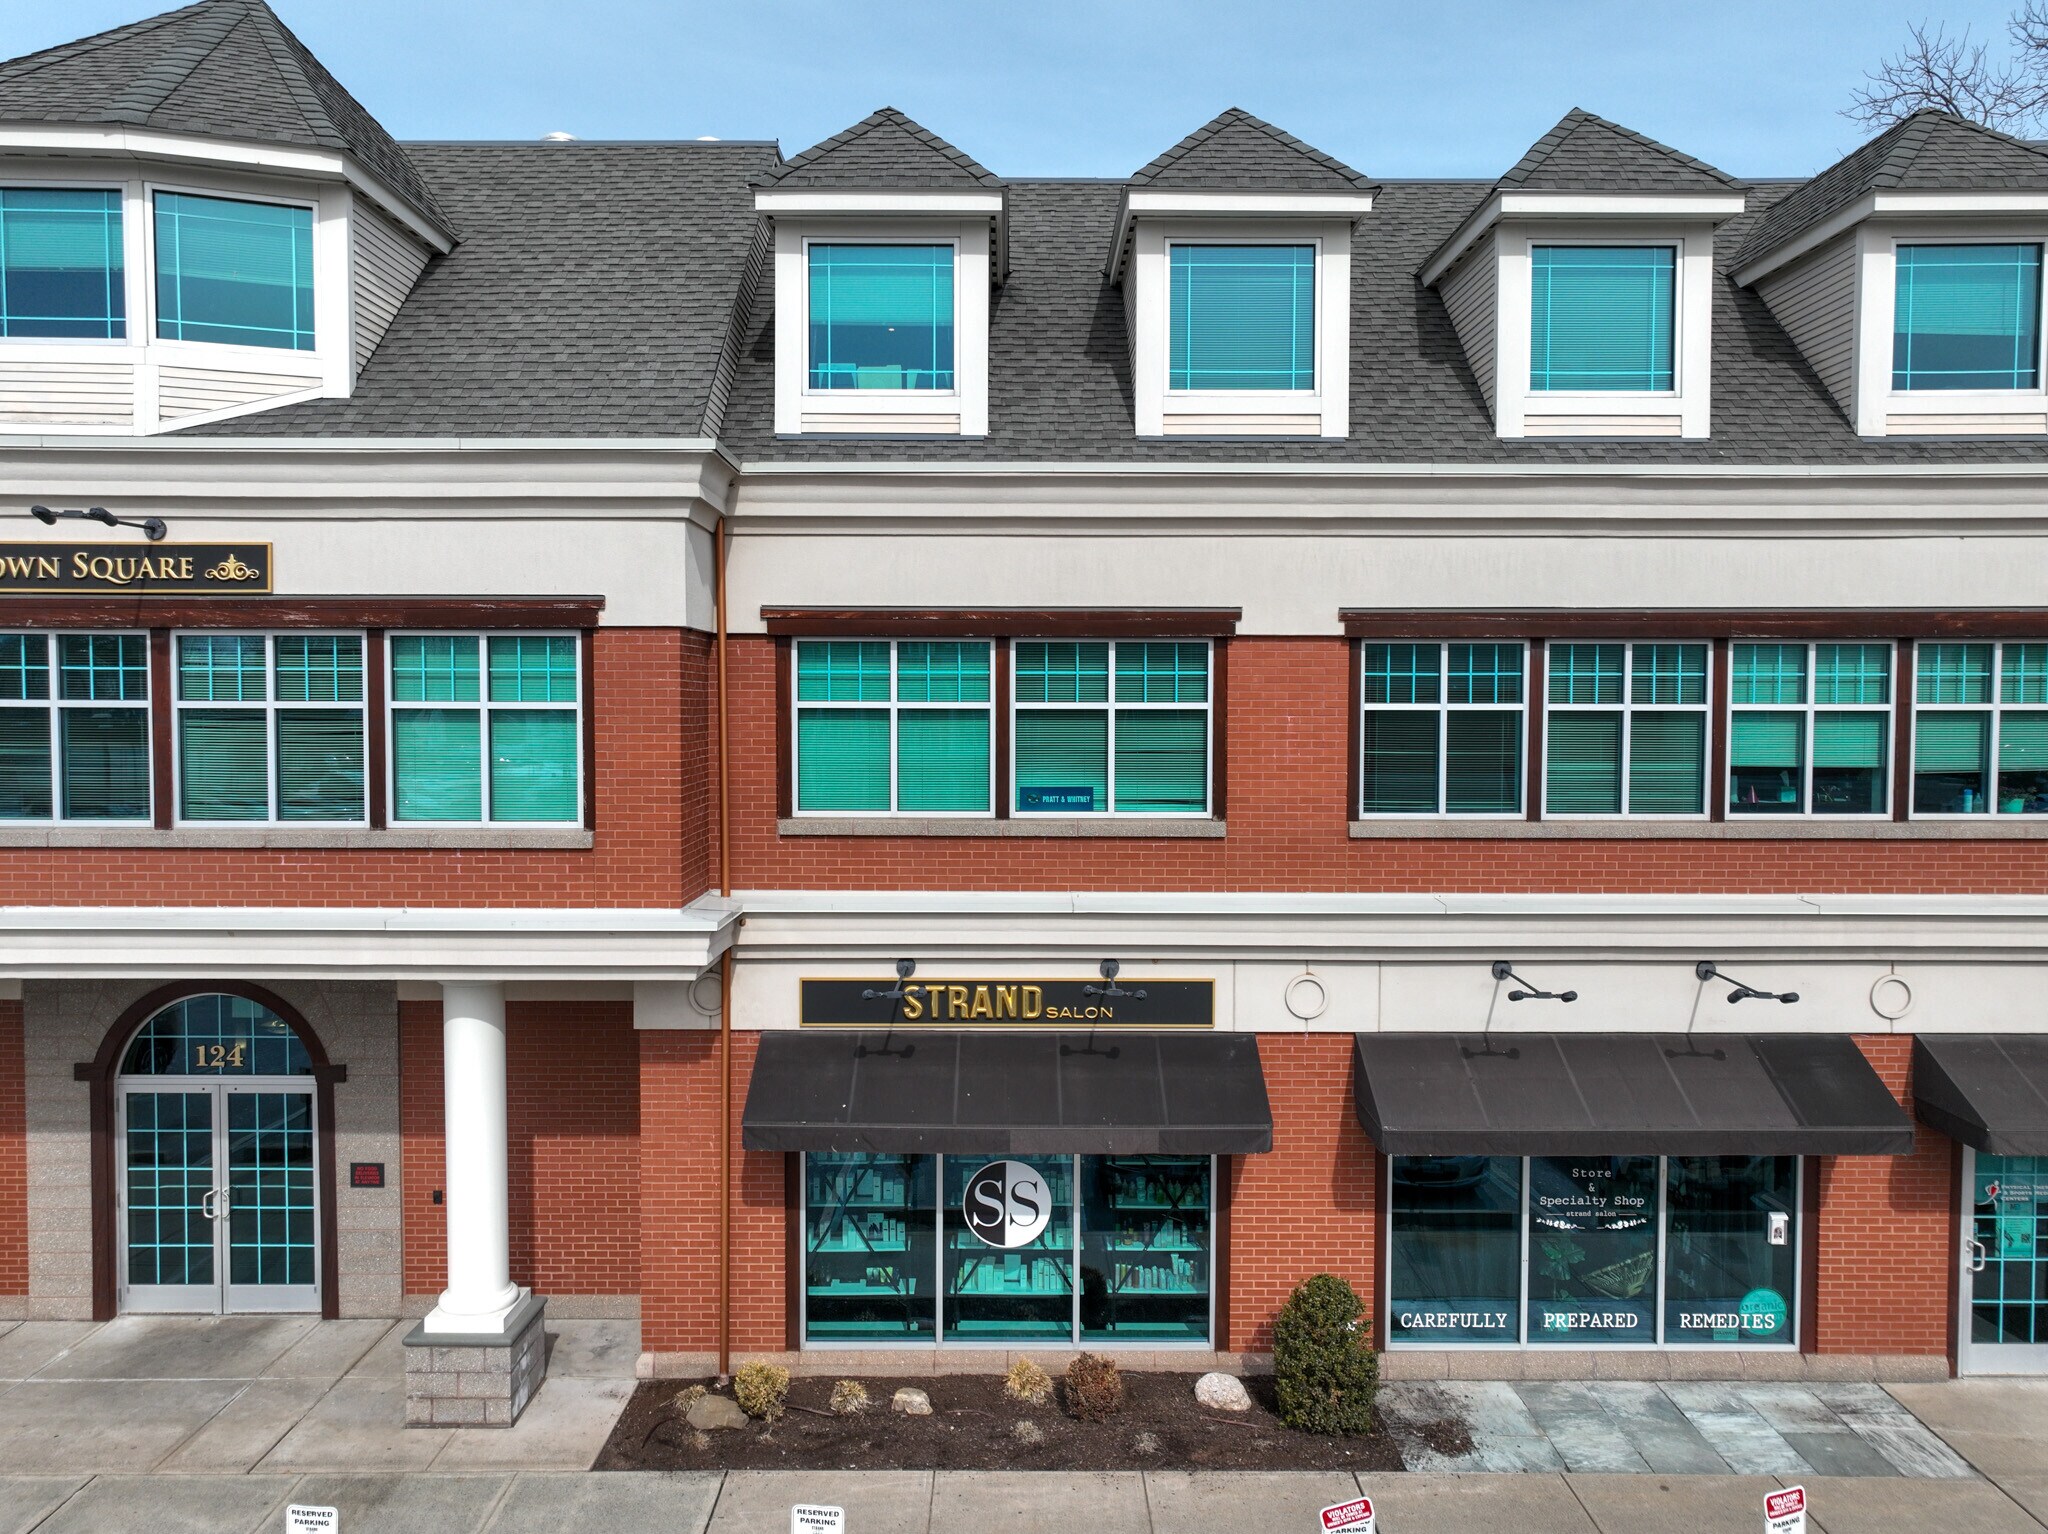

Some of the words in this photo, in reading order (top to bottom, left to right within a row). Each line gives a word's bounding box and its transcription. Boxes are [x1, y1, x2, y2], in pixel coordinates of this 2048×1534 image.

[72, 552, 195, 585] SQUARE
[1042, 795, 1059, 803] PRATT
[1061, 795, 1066, 803] &
[1067, 795, 1091, 803] WHITNEY
[903, 984, 1043, 1019] STRAND
[1046, 1006, 1114, 1019] SALON
[195, 1044, 244, 1068] 124
[1572, 1168, 1612, 1178] Store
[1588, 1182, 1596, 1192] &
[1540, 1195, 1607, 1208] Specialty
[1614, 1195, 1645, 1208] Shop
[1400, 1313, 1508, 1328] CAREFULLY
[1543, 1313, 1638, 1328] PREPARED
[1680, 1313, 1775, 1329] REMEDIES
[291, 1509, 333, 1518] RESERVED
[797, 1508, 839, 1518] RESERVED
[1326, 1502, 1366, 1519] VIOLATORS
[294, 1518, 330, 1527] PARKING
[800, 1517, 836, 1526] PARKING
[1772, 1516, 1801, 1529] PARKING
